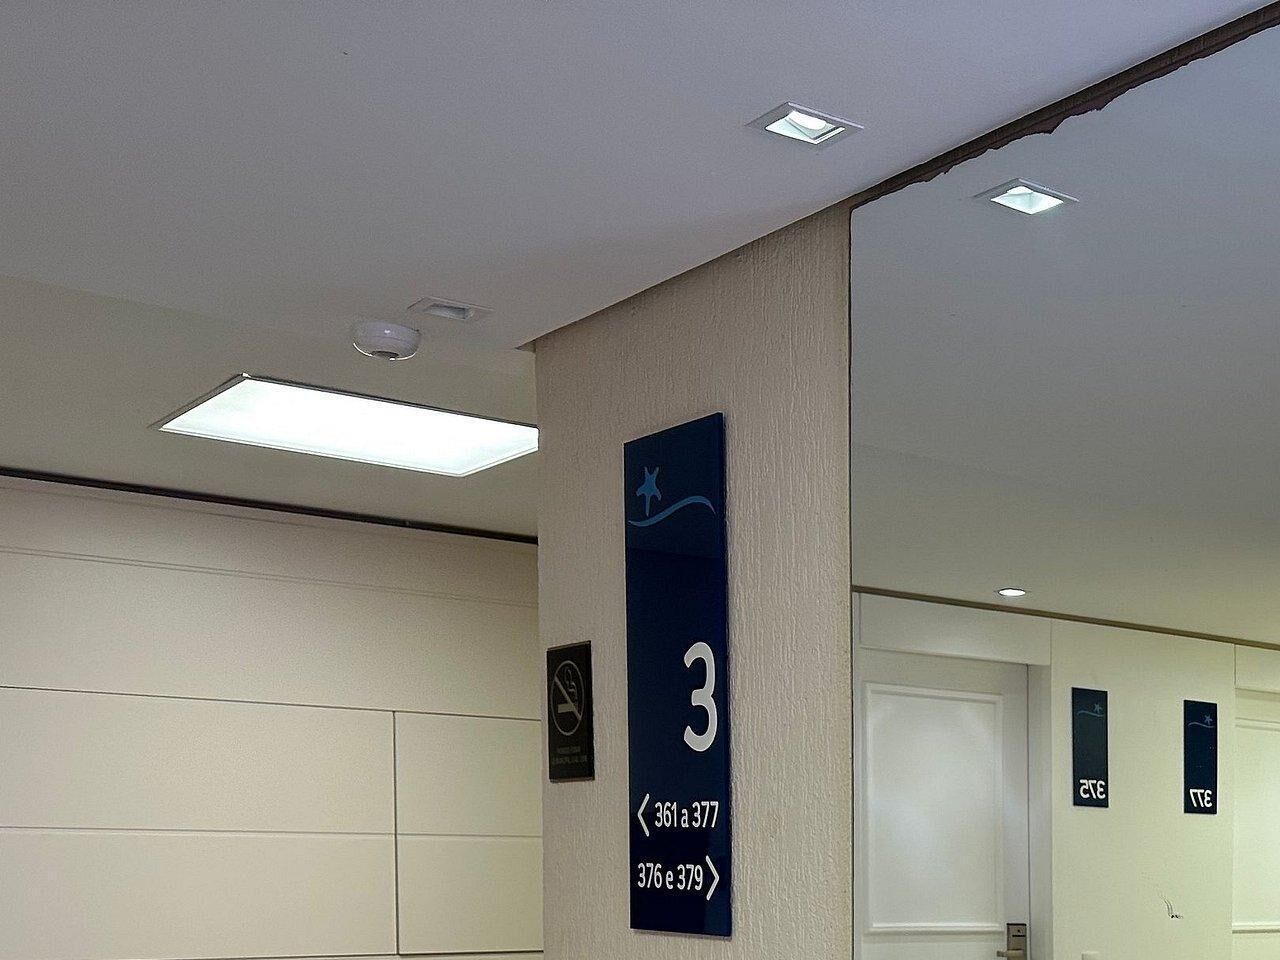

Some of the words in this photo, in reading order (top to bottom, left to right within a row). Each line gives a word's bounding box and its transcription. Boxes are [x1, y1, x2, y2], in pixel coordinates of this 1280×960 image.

[683, 641, 718, 752] 3
[654, 801, 677, 828] 361
[681, 808, 690, 828] a
[692, 801, 719, 828] 377
[637, 862, 663, 889] 376
[665, 870, 674, 890] e
[677, 864, 703, 891] 379
